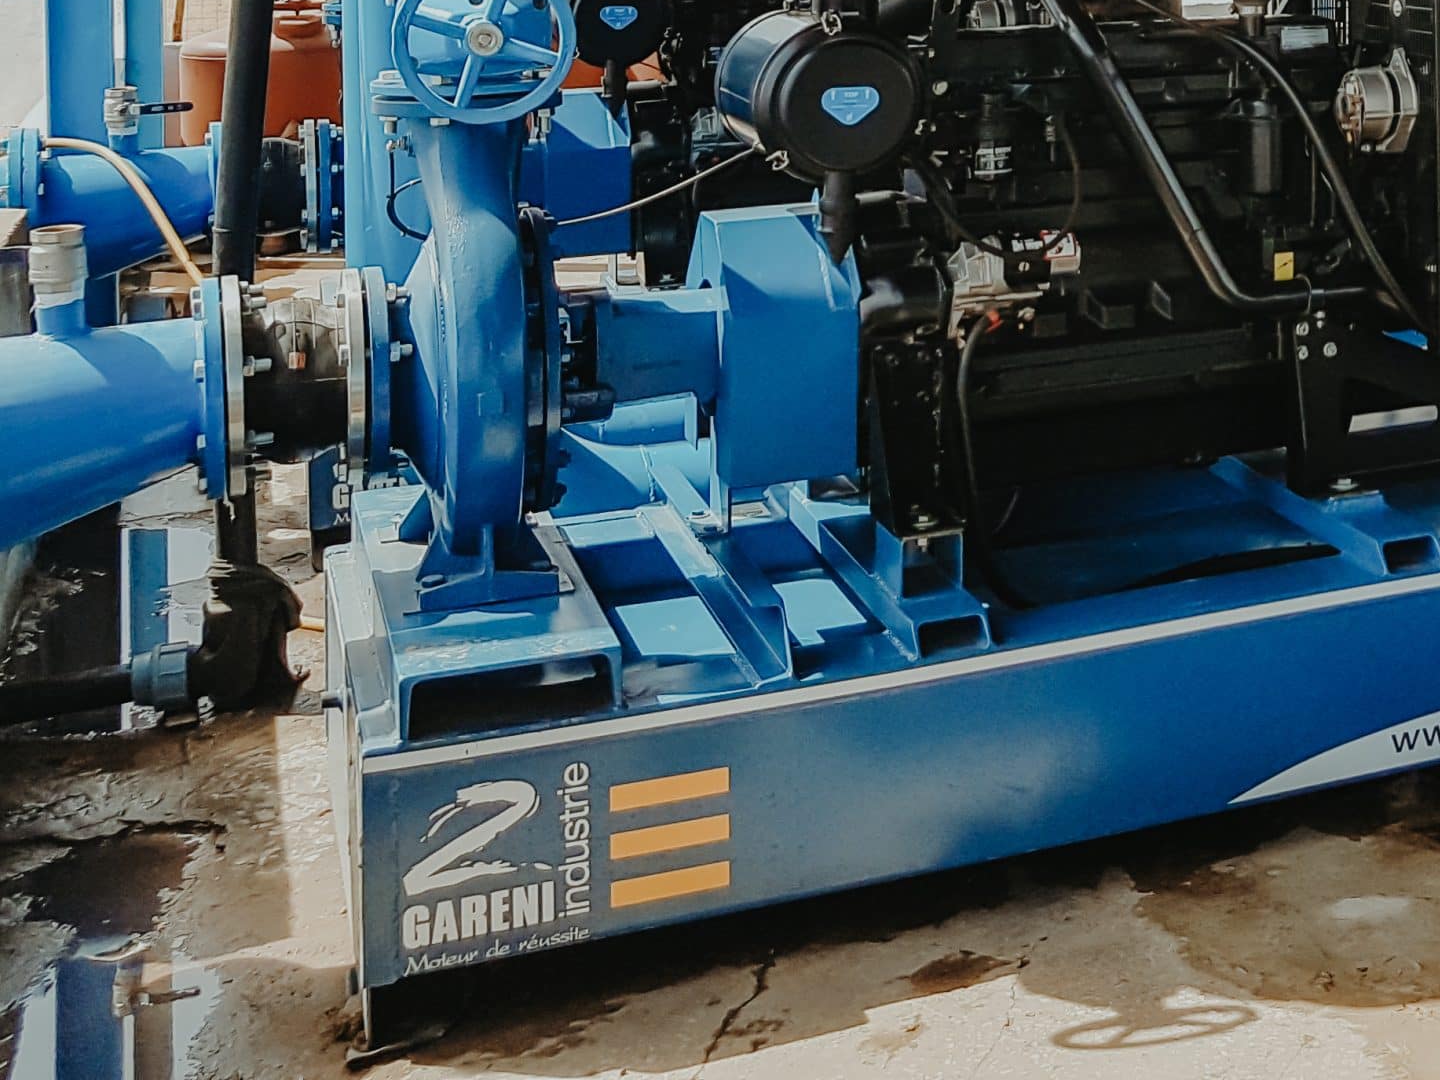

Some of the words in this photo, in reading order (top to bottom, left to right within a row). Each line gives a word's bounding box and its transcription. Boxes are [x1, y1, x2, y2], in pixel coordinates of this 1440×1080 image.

[402, 780, 549, 897] 2
[556, 762, 591, 918] industrie
[402, 881, 555, 949] GARENI
[403, 950, 479, 977] Moteur
[486, 939, 511, 957] de
[519, 927, 591, 951] réussite
